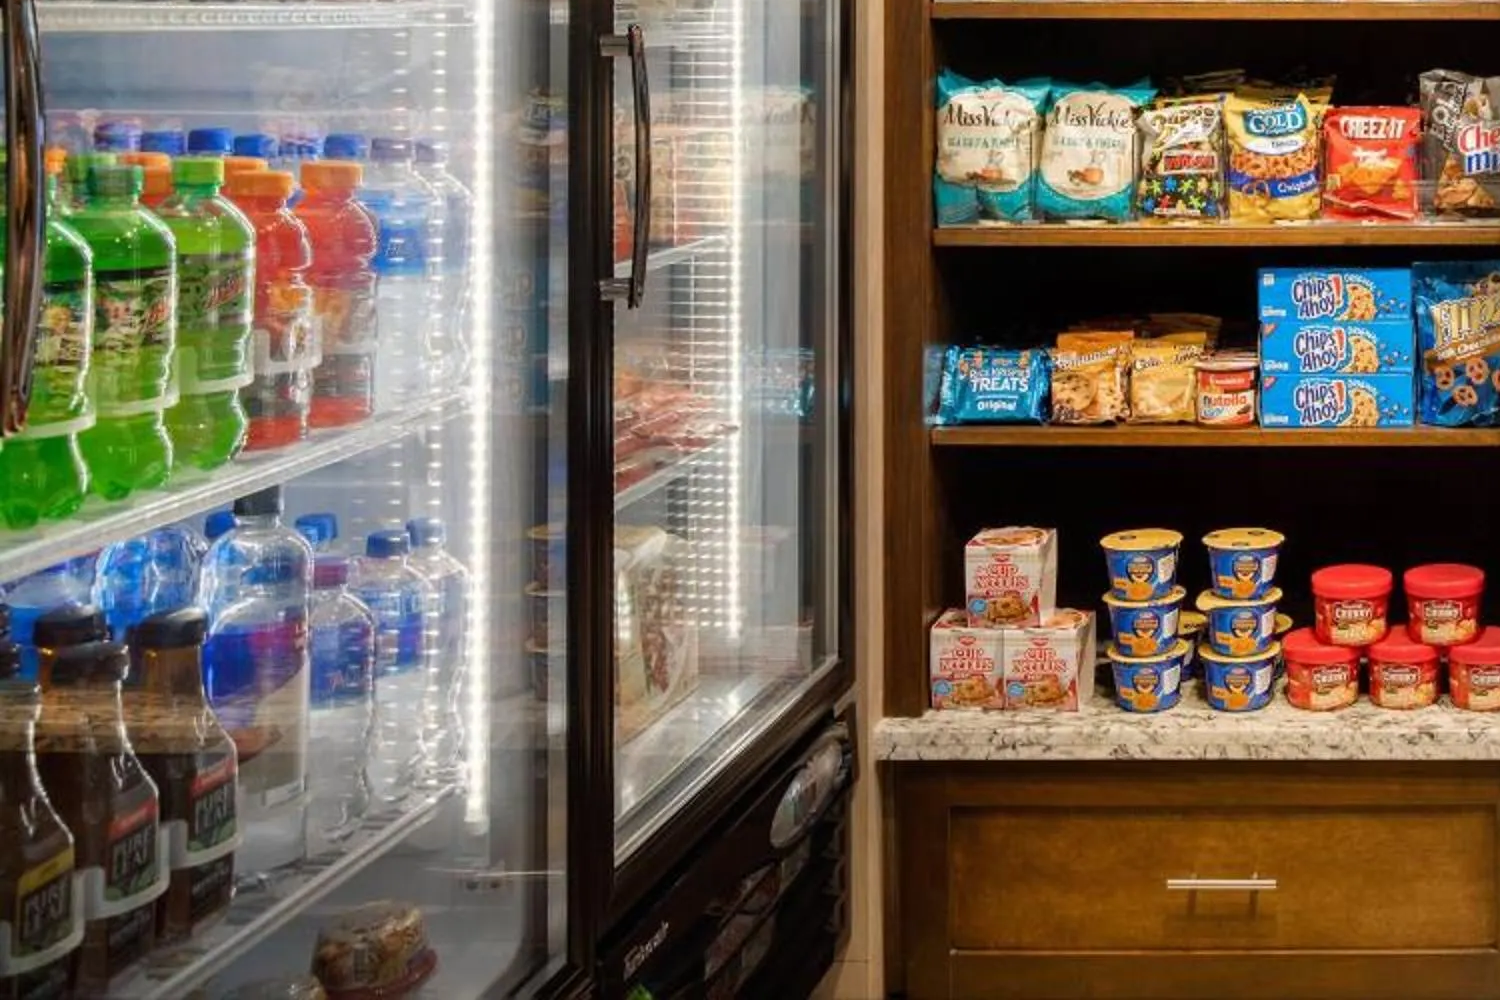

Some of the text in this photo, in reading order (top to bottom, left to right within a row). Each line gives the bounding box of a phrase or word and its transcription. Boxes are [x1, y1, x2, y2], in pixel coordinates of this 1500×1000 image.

[1249, 112, 1304, 133] GOLD
[1293, 279, 1333, 303] Chips
[1295, 331, 1336, 355] Chips
[971, 377, 1029, 393] TREATS
[1295, 384, 1336, 408] Chips
